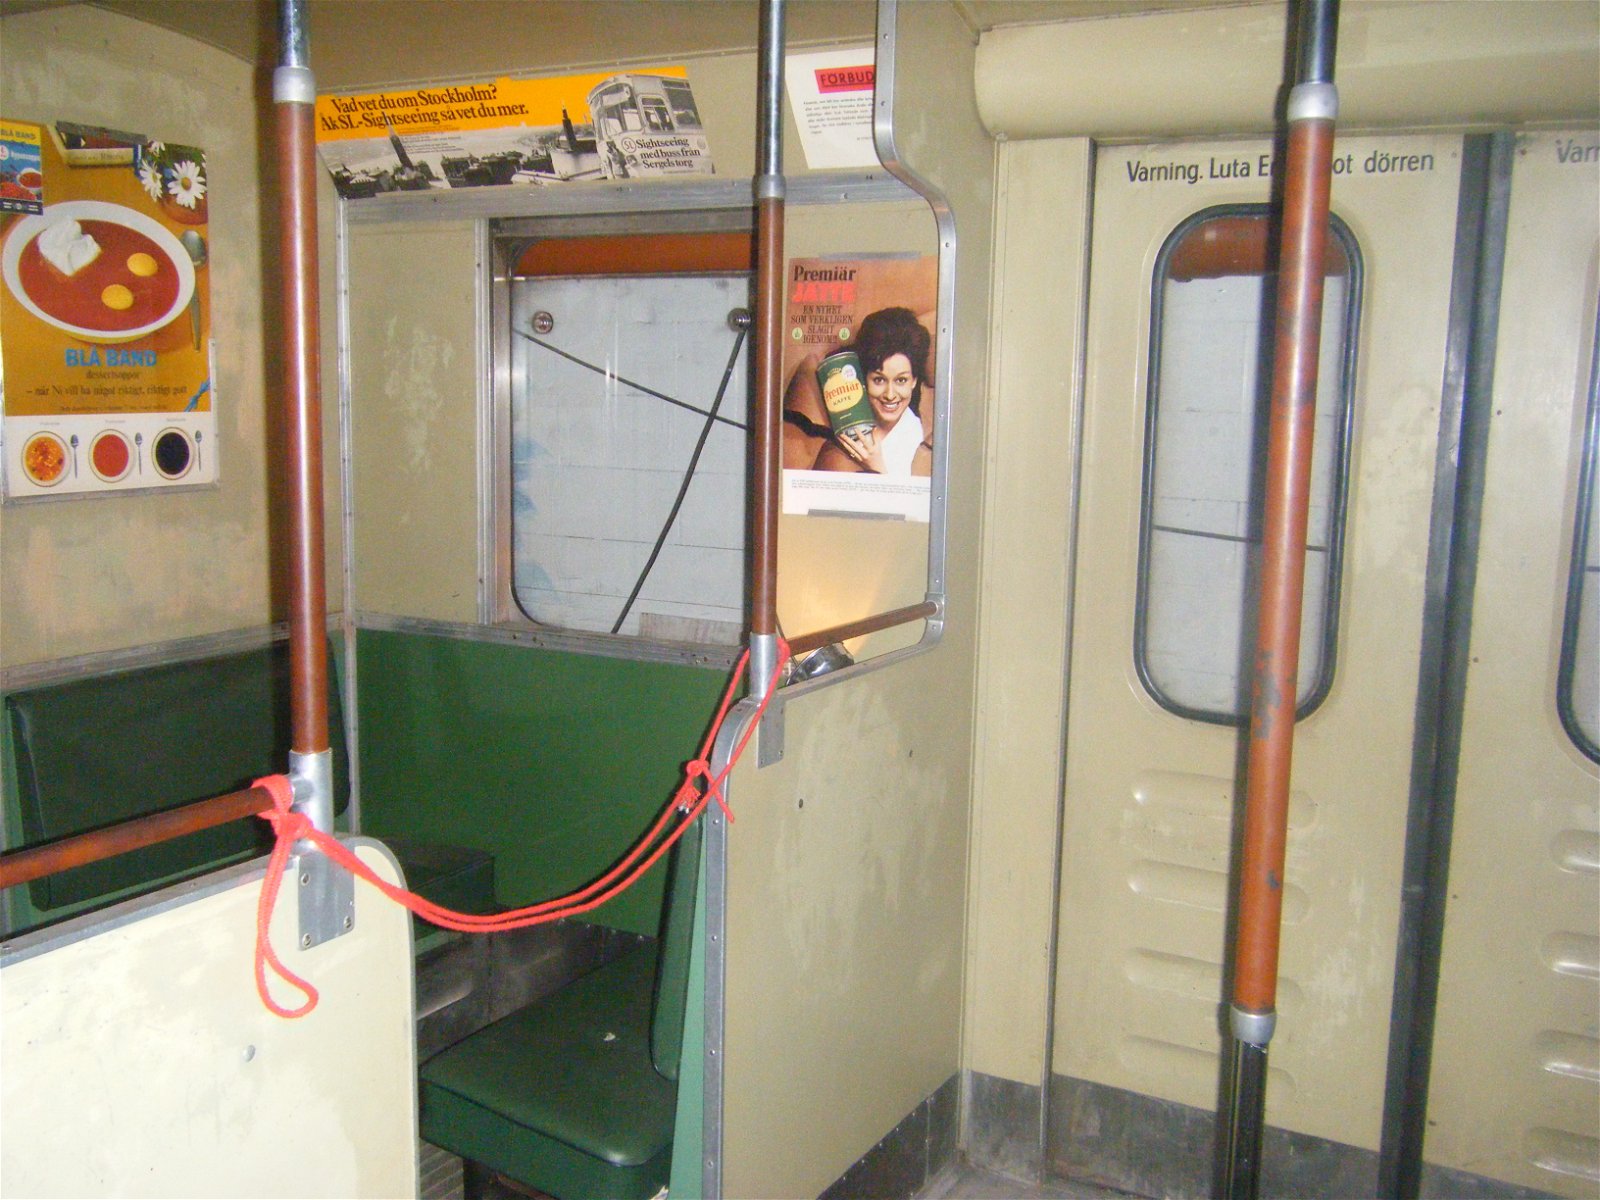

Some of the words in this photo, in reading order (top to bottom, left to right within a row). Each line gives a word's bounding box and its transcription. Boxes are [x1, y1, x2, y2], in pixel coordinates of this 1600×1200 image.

[331, 97, 358, 113] Vad
[358, 98, 378, 111] vet
[378, 94, 395, 109] du
[396, 96, 418, 108] om
[417, 84, 497, 106] Stockholm?
[456, 106, 477, 119] vet
[477, 103, 496, 118] du
[497, 104, 529, 116] mer.
[635, 137, 690, 149] Sightseeing
[640, 149, 660, 160] med
[660, 149, 681, 158] buss
[642, 158, 676, 169] Sergels
[676, 159, 694, 168] torg
[1126, 161, 1203, 184] Varning.
[1209, 157, 1251, 179] Luta
[1364, 150, 1434, 173] dörren
[793, 265, 857, 281] Premiär
[65, 345, 101, 366] BLÅ
[105, 348, 157, 367] BAND
